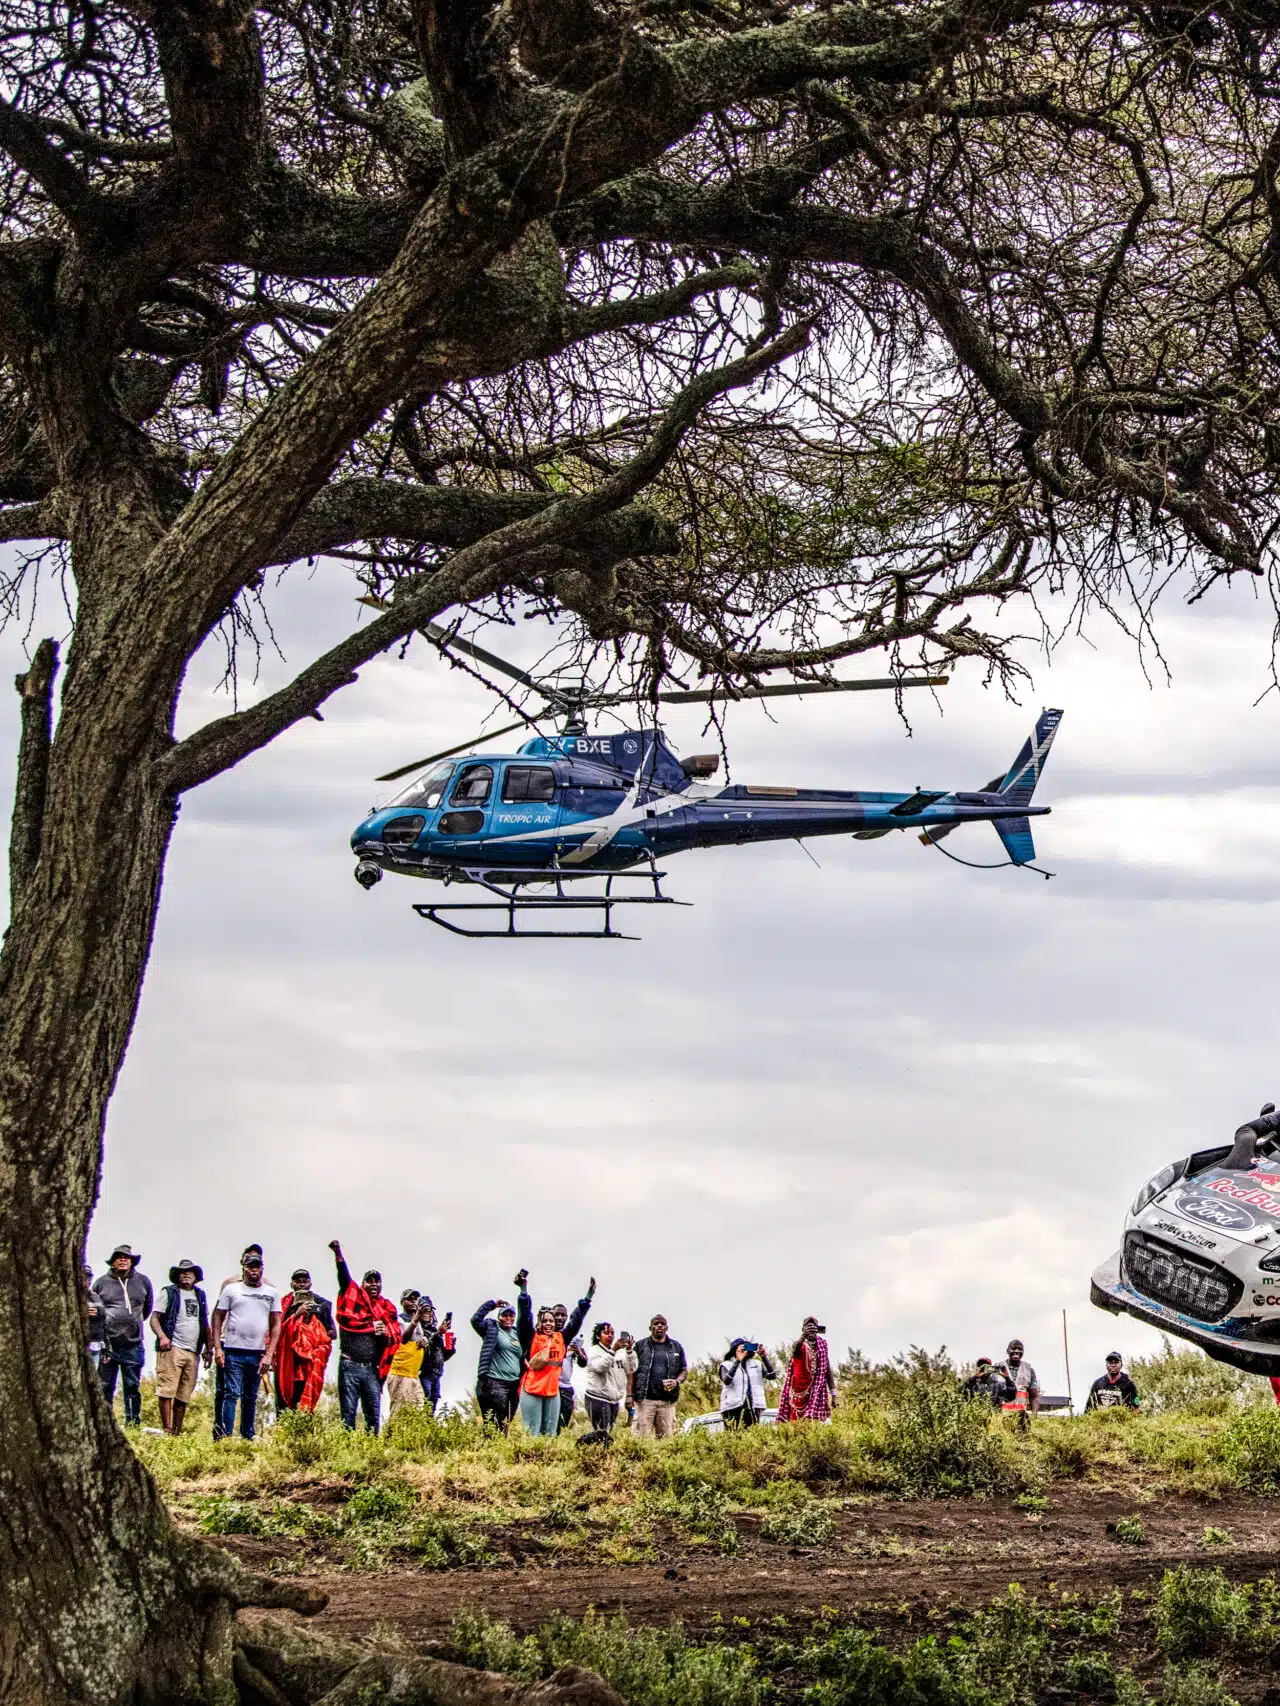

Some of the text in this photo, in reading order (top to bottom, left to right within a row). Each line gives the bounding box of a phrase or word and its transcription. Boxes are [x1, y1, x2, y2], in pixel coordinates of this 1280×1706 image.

[499, 815, 551, 823] TROPIC AIR
[1185, 1199, 1243, 1226] Ford
[1154, 1219, 1217, 1249] SafetyCulture
